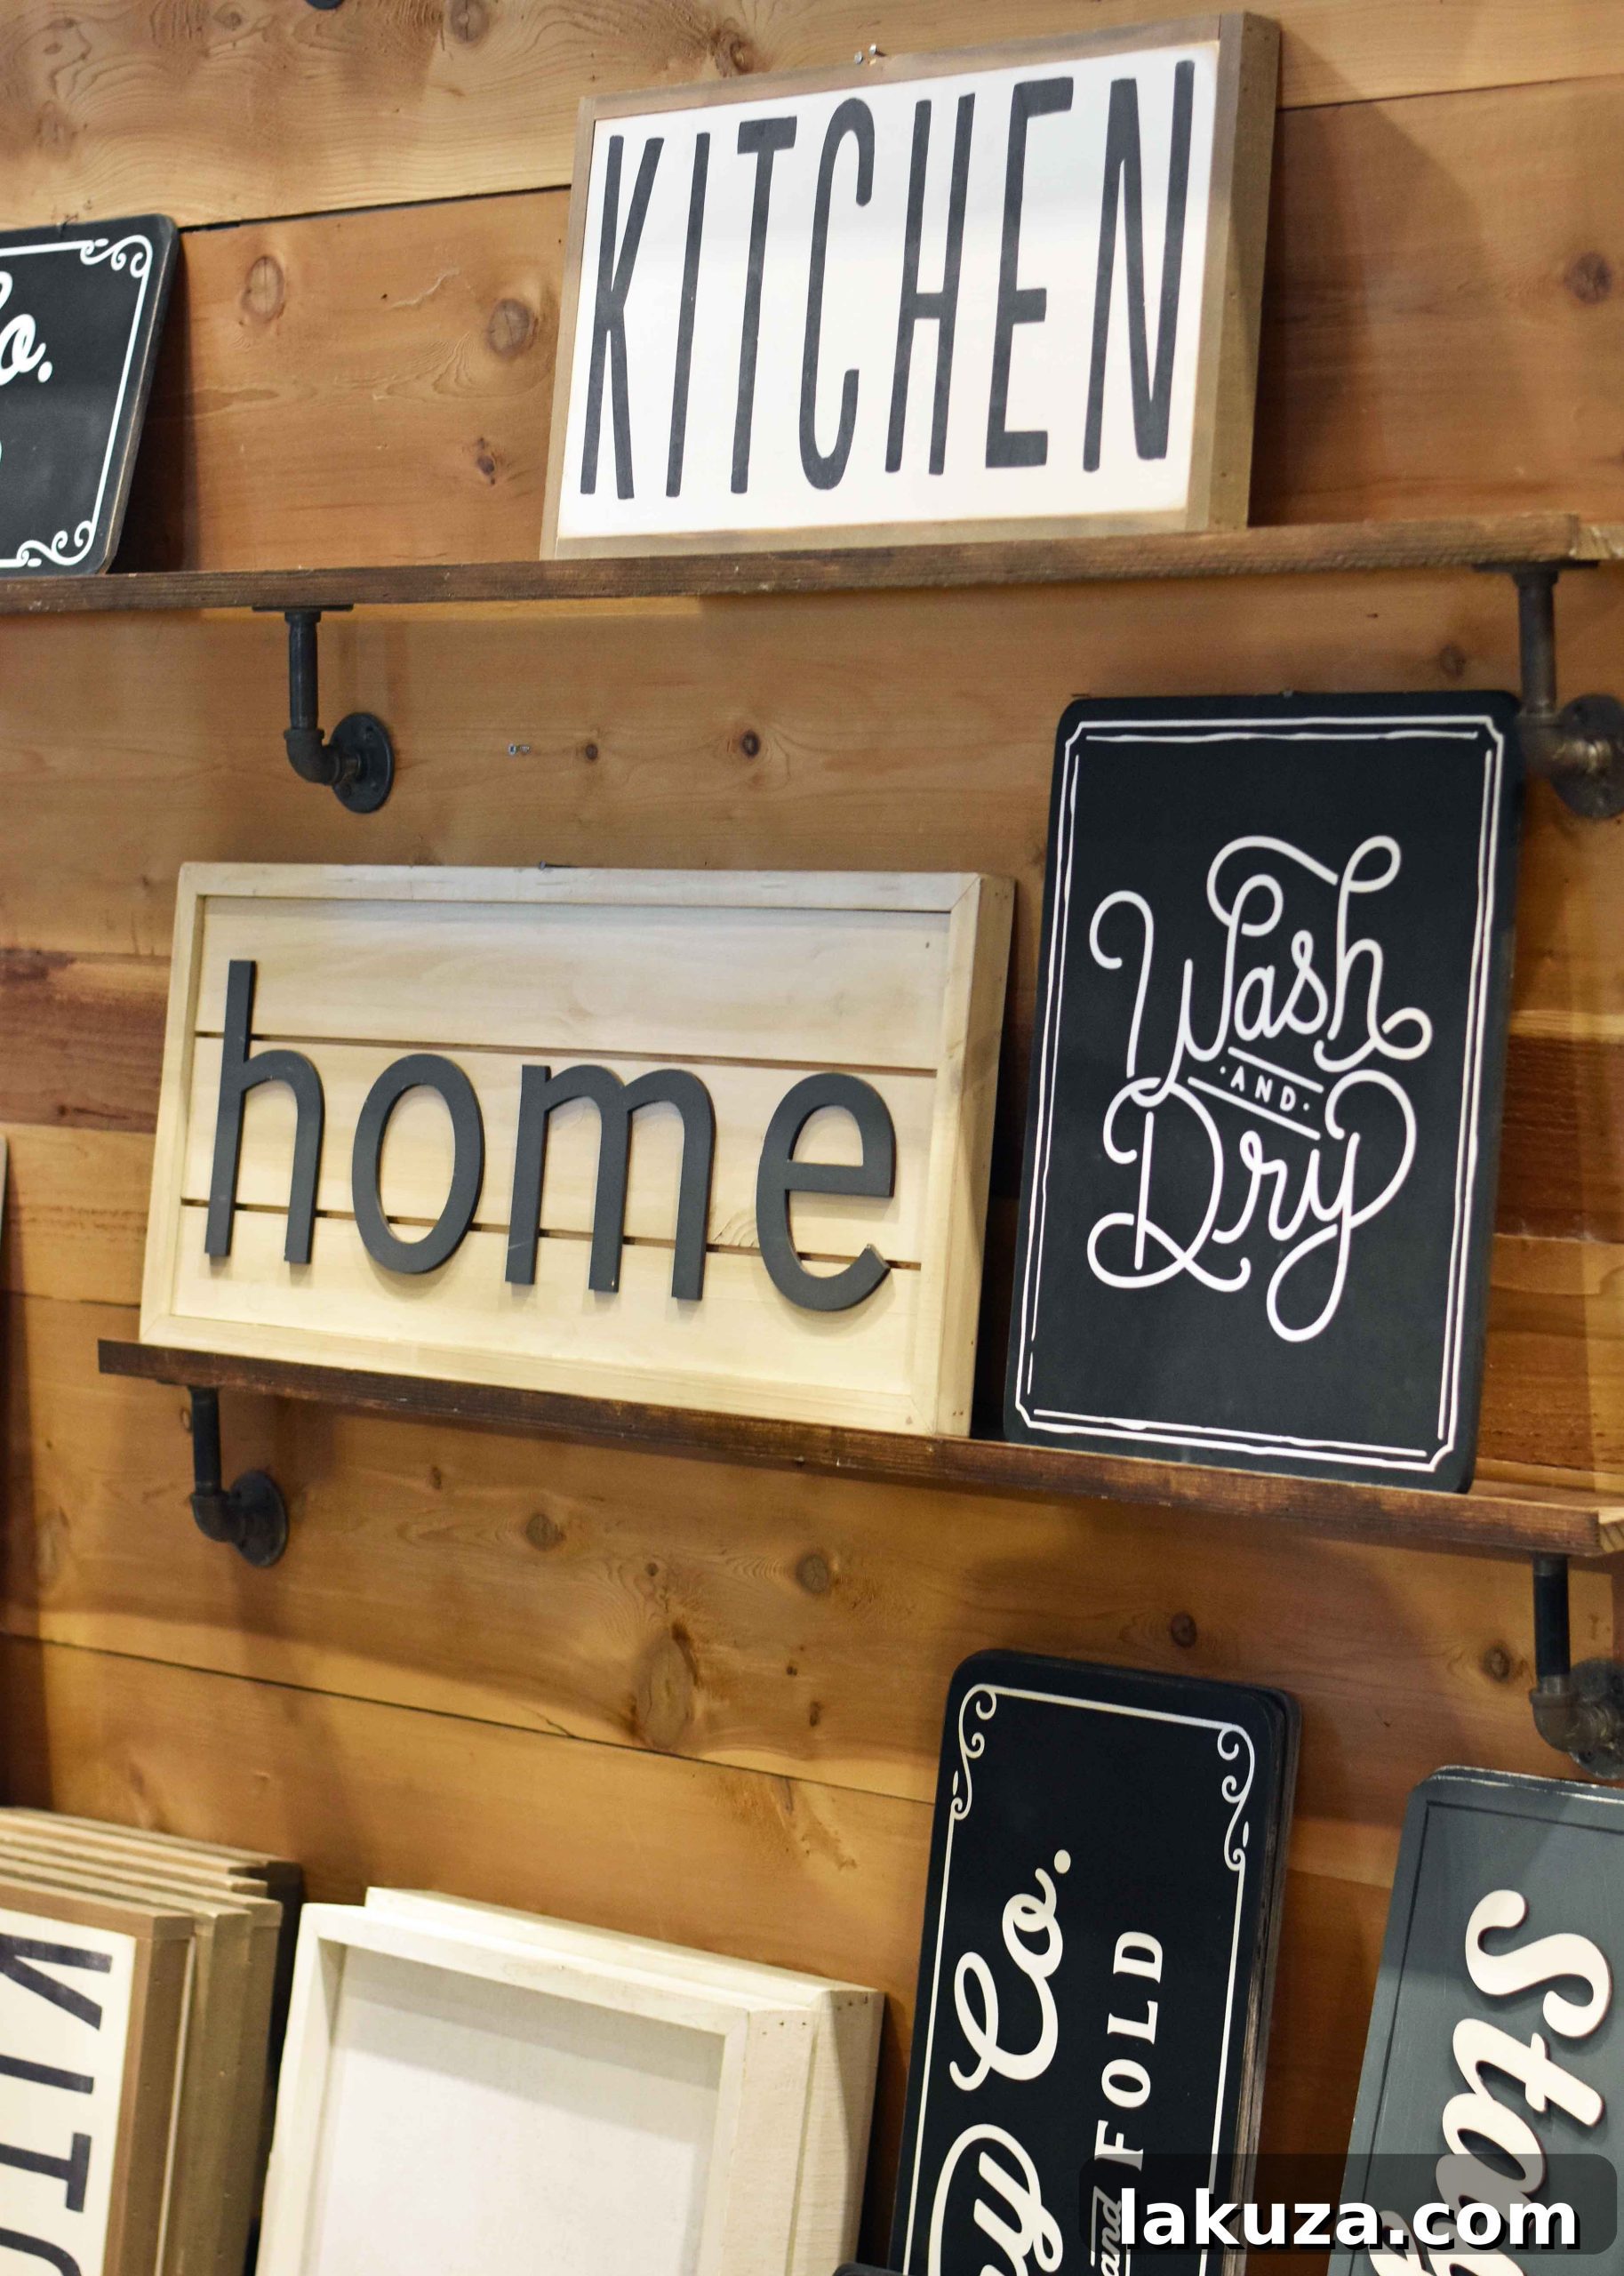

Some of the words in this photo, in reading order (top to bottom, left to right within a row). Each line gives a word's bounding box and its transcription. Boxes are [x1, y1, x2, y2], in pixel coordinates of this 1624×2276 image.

[580, 60, 1196, 500] KITCHEN
[1088, 836, 1432, 1108] Wash
[204, 959, 896, 1311] home
[1087, 1069, 1416, 1342] Dry
[949, 1848, 1071, 2092] Co.
[1093, 1930, 1164, 2172] FOLD
